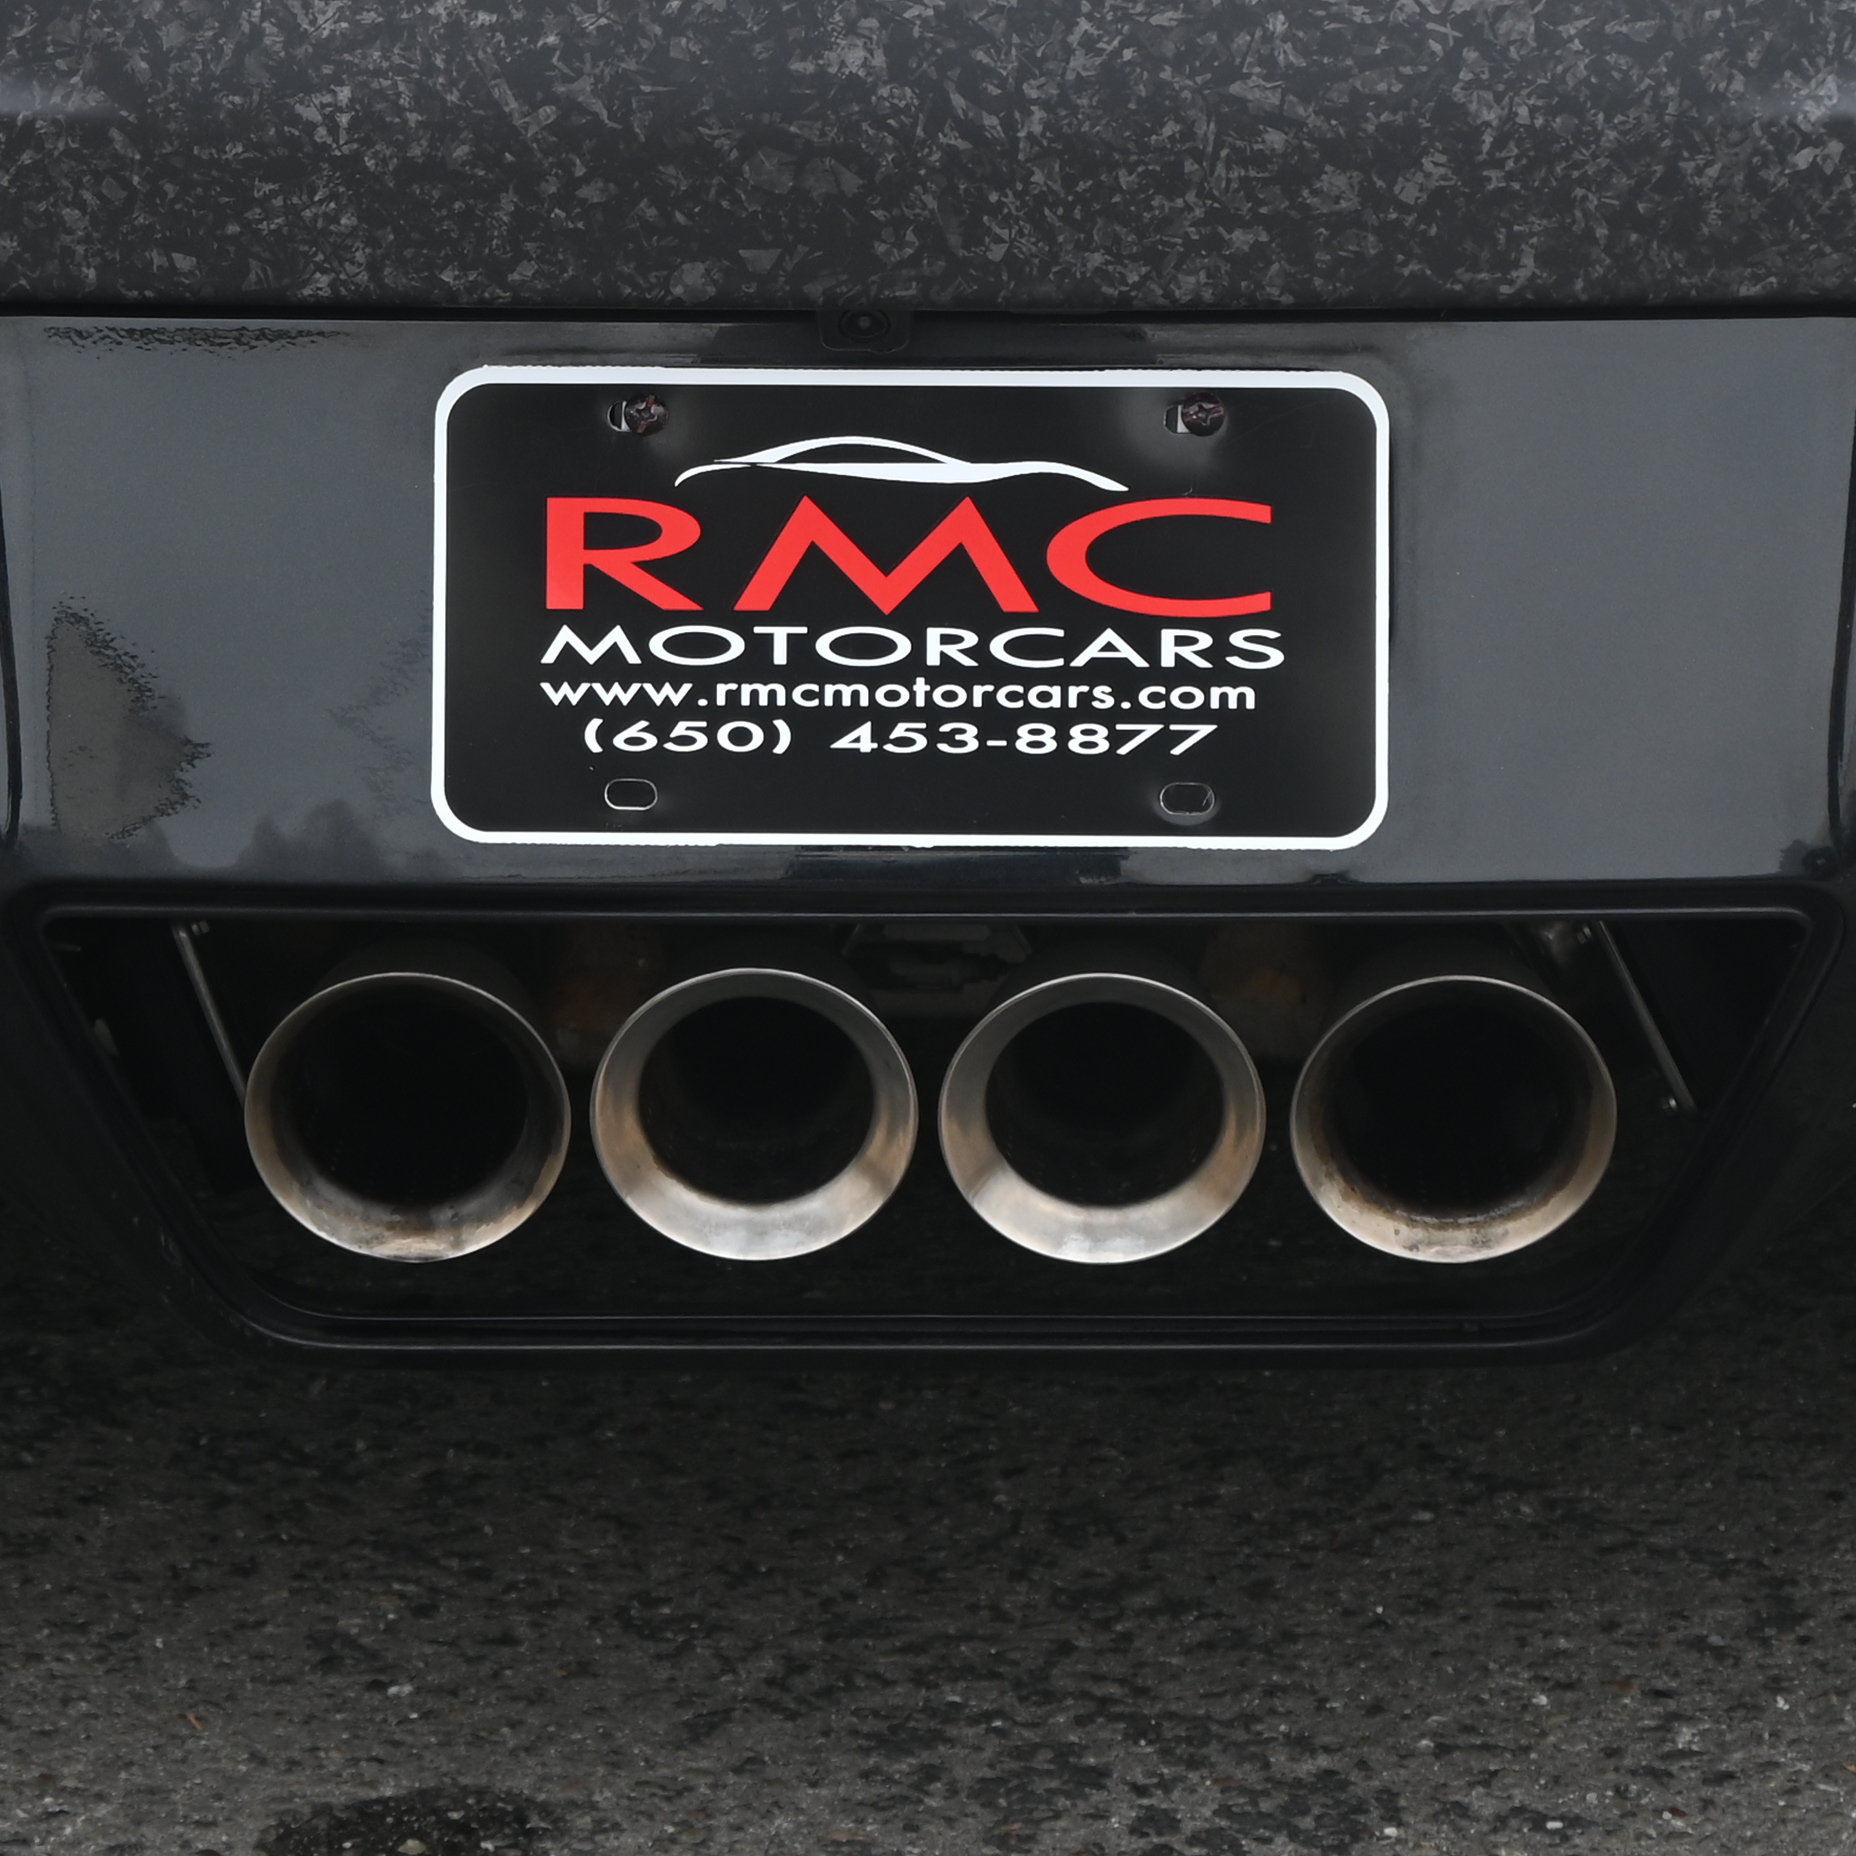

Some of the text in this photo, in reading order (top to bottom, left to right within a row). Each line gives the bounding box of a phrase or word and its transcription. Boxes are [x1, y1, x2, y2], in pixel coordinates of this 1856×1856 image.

[546, 495, 1272, 618] RMC
[540, 625, 1285, 669] MOTORCARS
[539, 677, 1256, 710] www.rmcmotorcars.com
[584, 718, 1218, 756] (650) 453-8877
